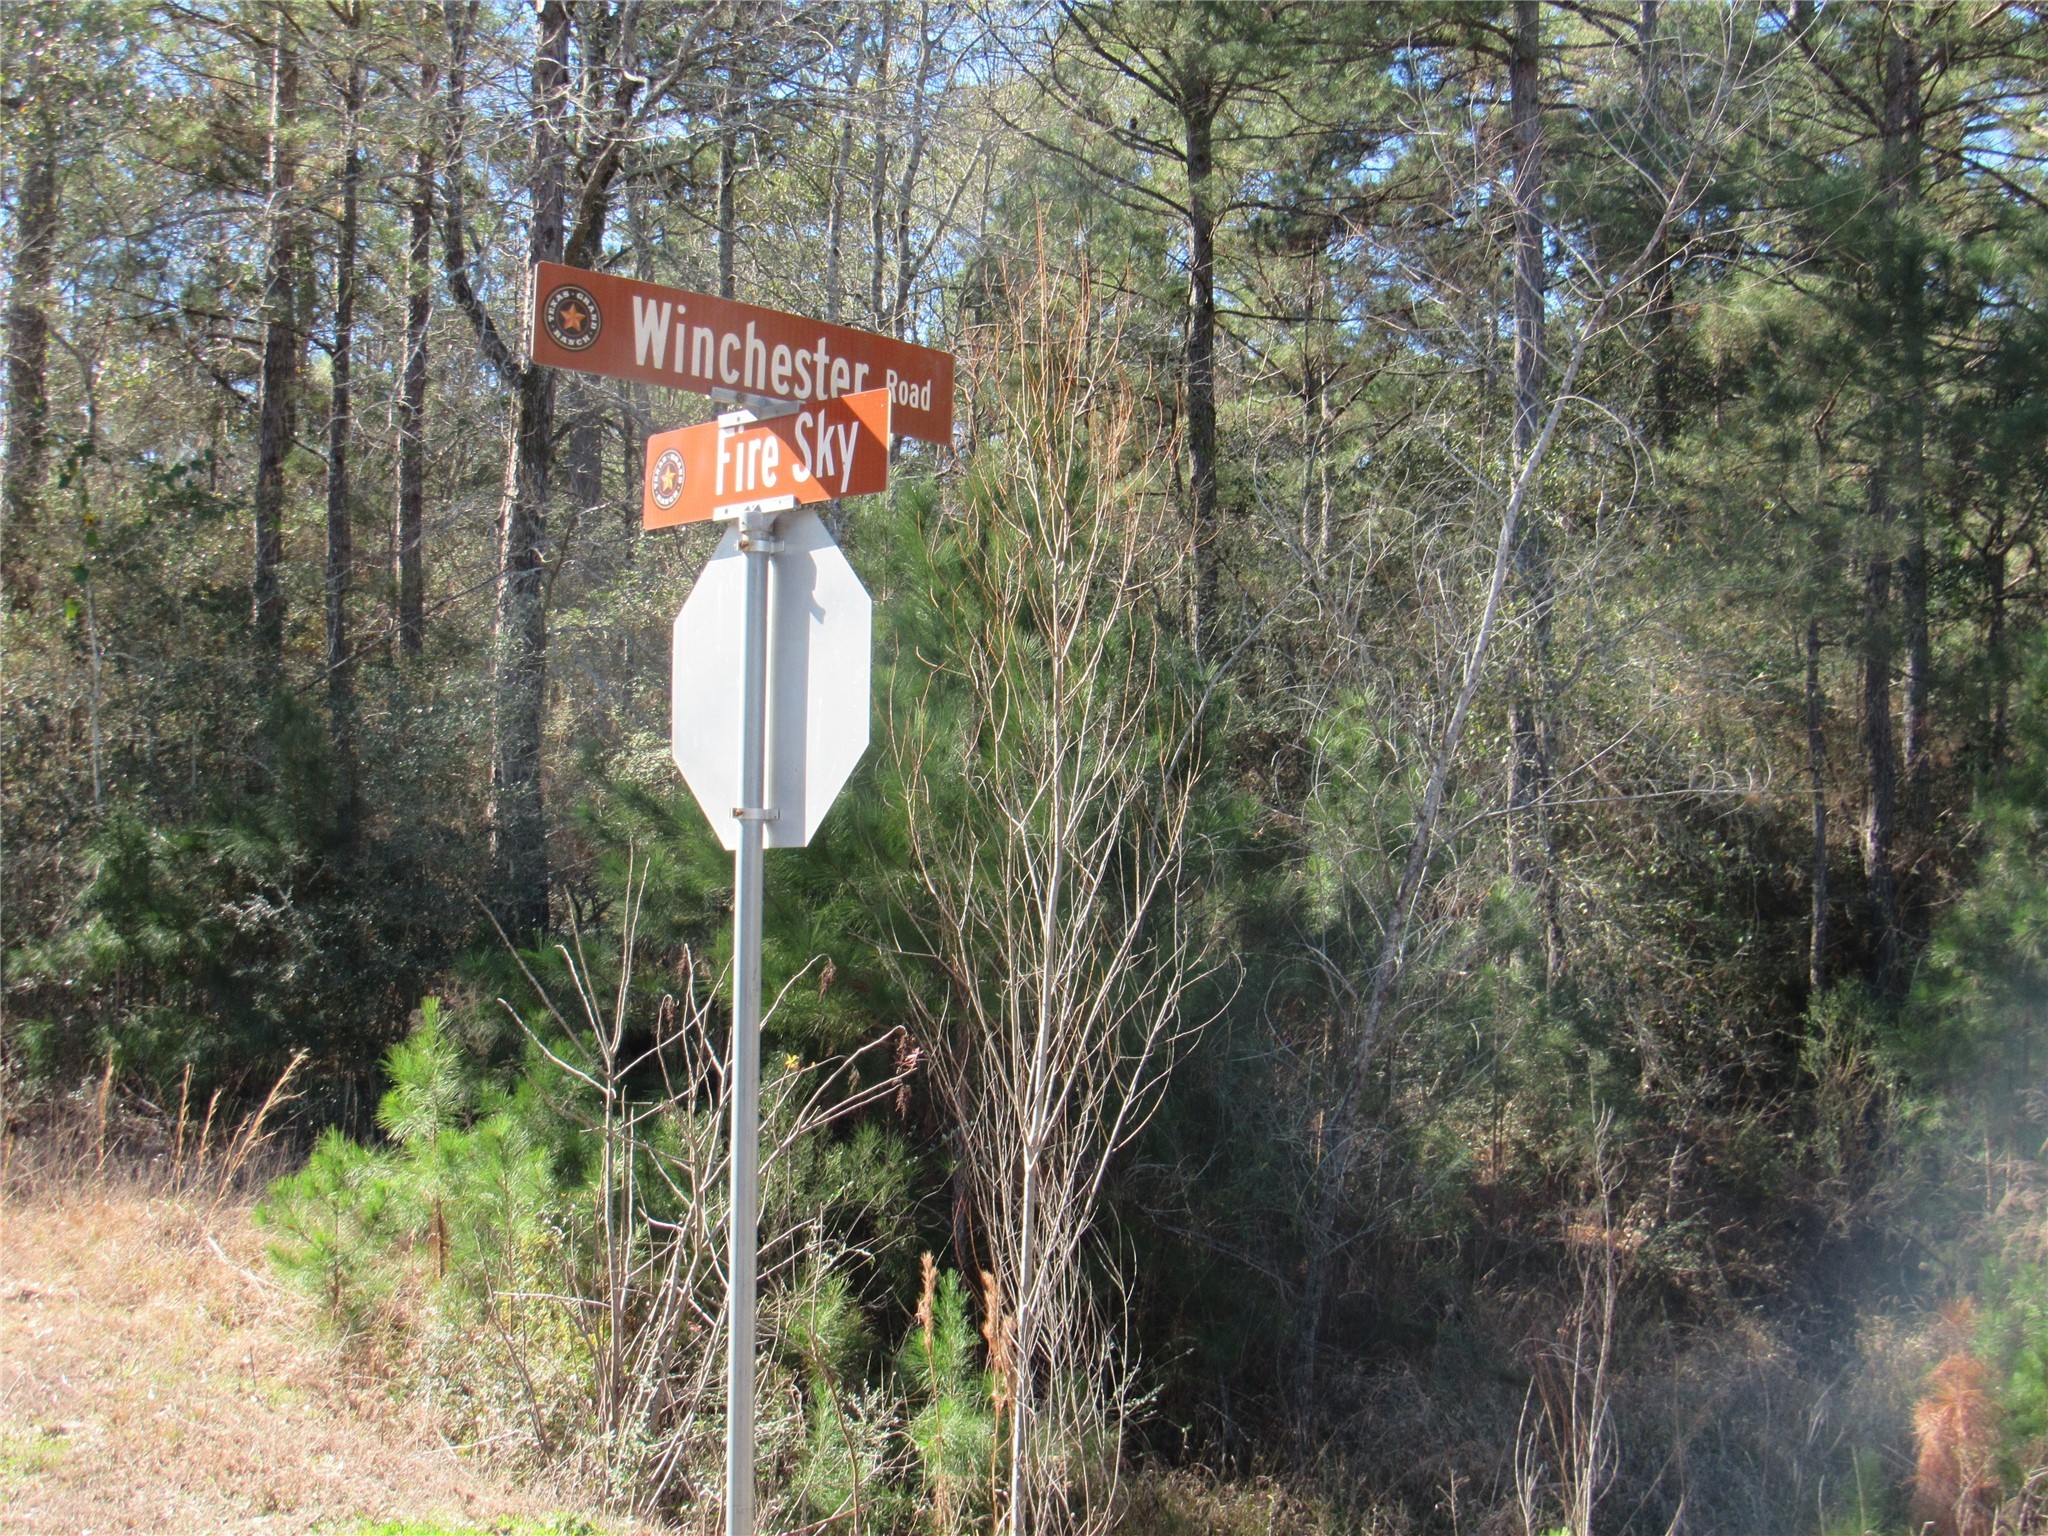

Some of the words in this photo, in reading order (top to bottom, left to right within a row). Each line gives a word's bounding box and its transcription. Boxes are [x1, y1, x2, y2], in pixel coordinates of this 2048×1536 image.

[547, 290, 570, 322] TEXAS
[576, 292, 598, 330] GRAND
[553, 329, 591, 346] RANCH
[632, 295, 869, 401] Winchester
[886, 368, 932, 411] Road
[715, 425, 779, 495] Fire
[792, 408, 859, 493] Sky
